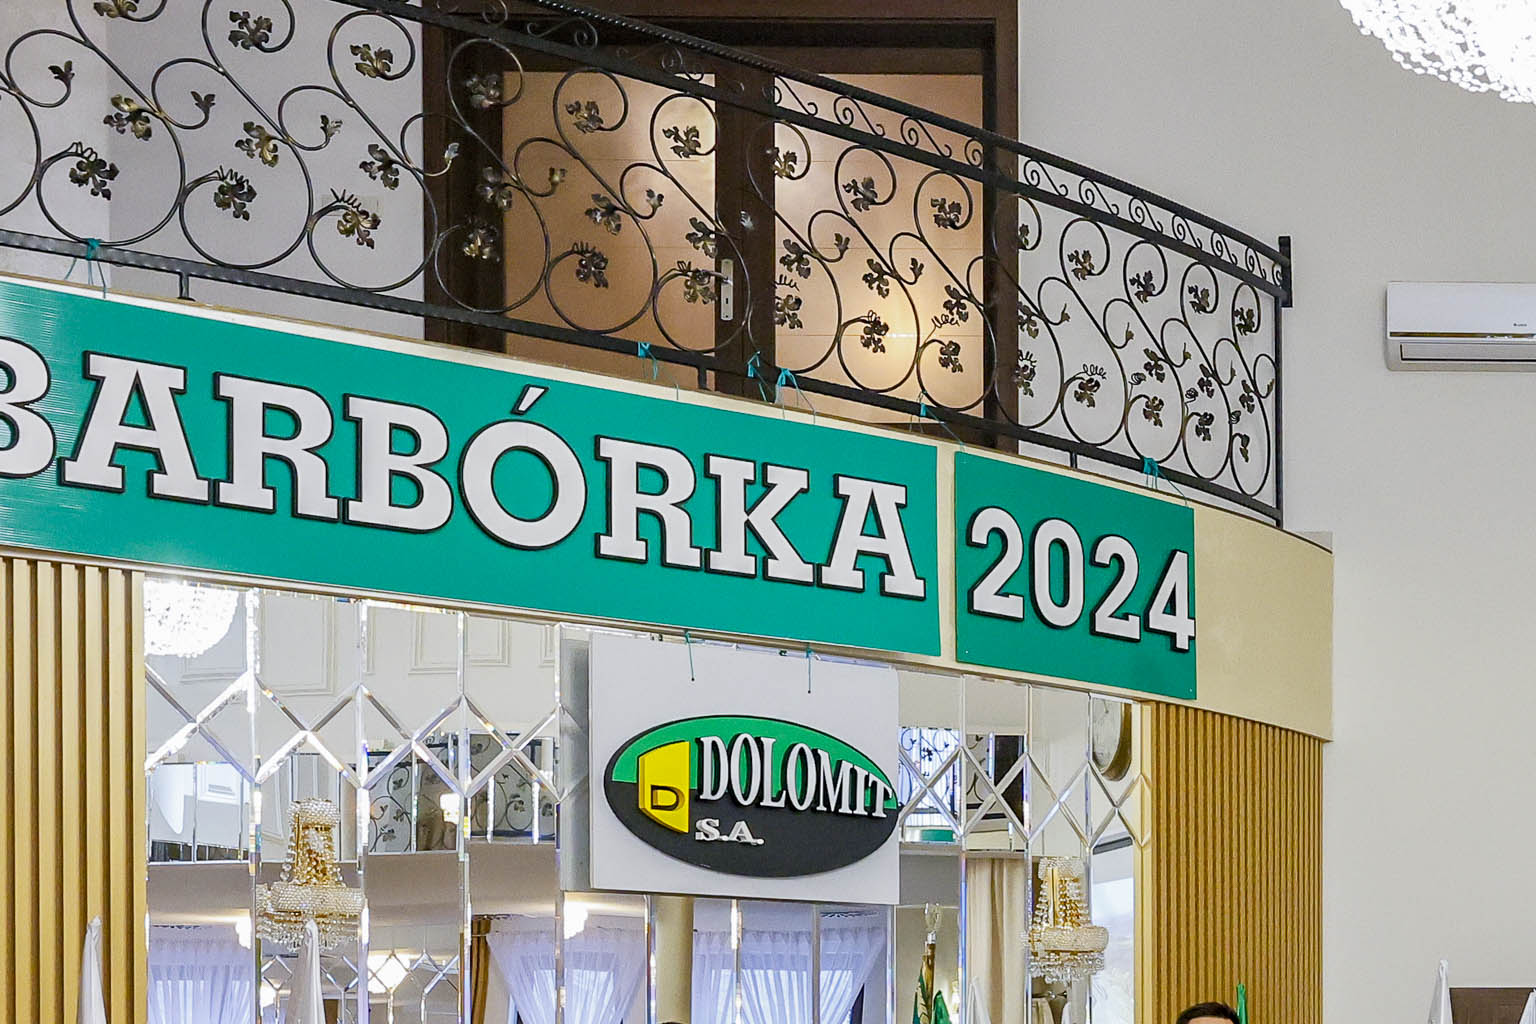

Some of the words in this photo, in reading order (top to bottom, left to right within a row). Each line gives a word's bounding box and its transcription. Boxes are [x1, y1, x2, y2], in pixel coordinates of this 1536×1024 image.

[966, 505, 1197, 653] 2024
[697, 732, 893, 819] DOLOMIT
[694, 818, 765, 846] S.A.
